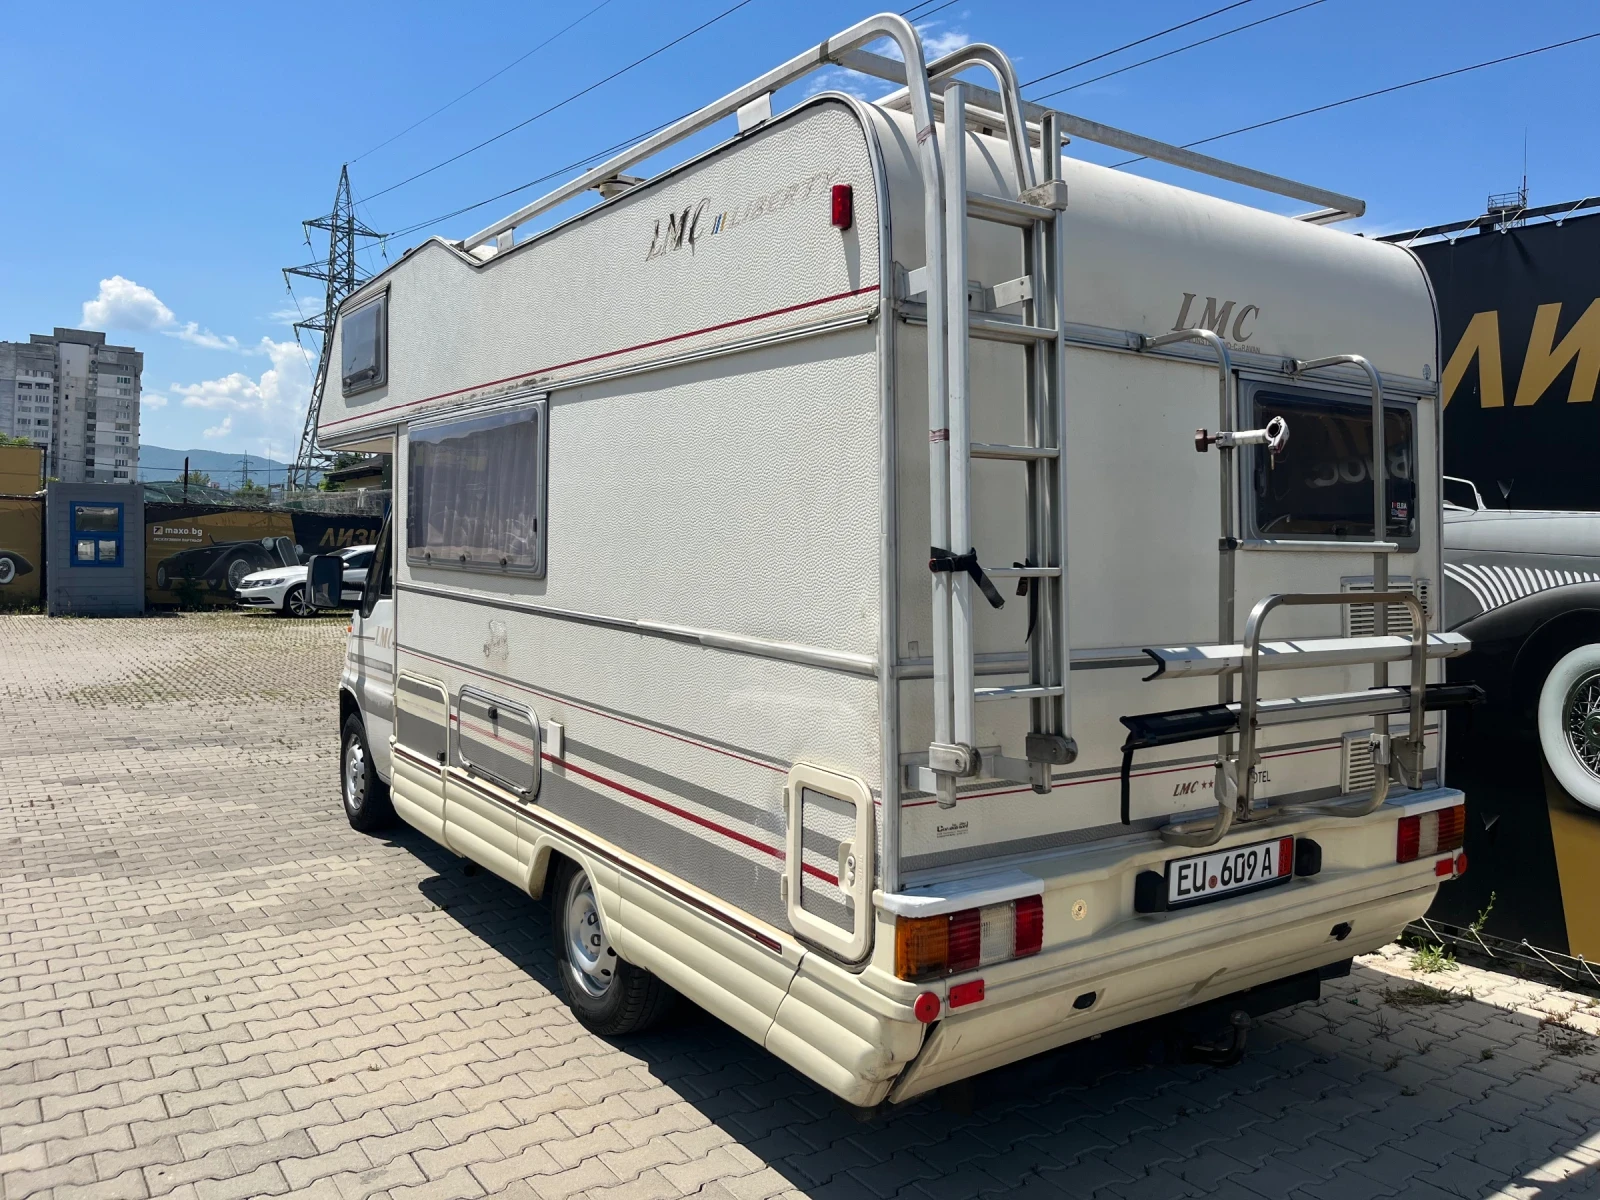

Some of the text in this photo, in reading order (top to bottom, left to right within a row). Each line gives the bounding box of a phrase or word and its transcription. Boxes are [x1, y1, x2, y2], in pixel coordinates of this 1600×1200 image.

[1171, 292, 1260, 342] LMC
[165, 527, 203, 537] maxo.bg
[1173, 781, 1199, 797] LMC
[1177, 847, 1272, 896] EU 609 A
